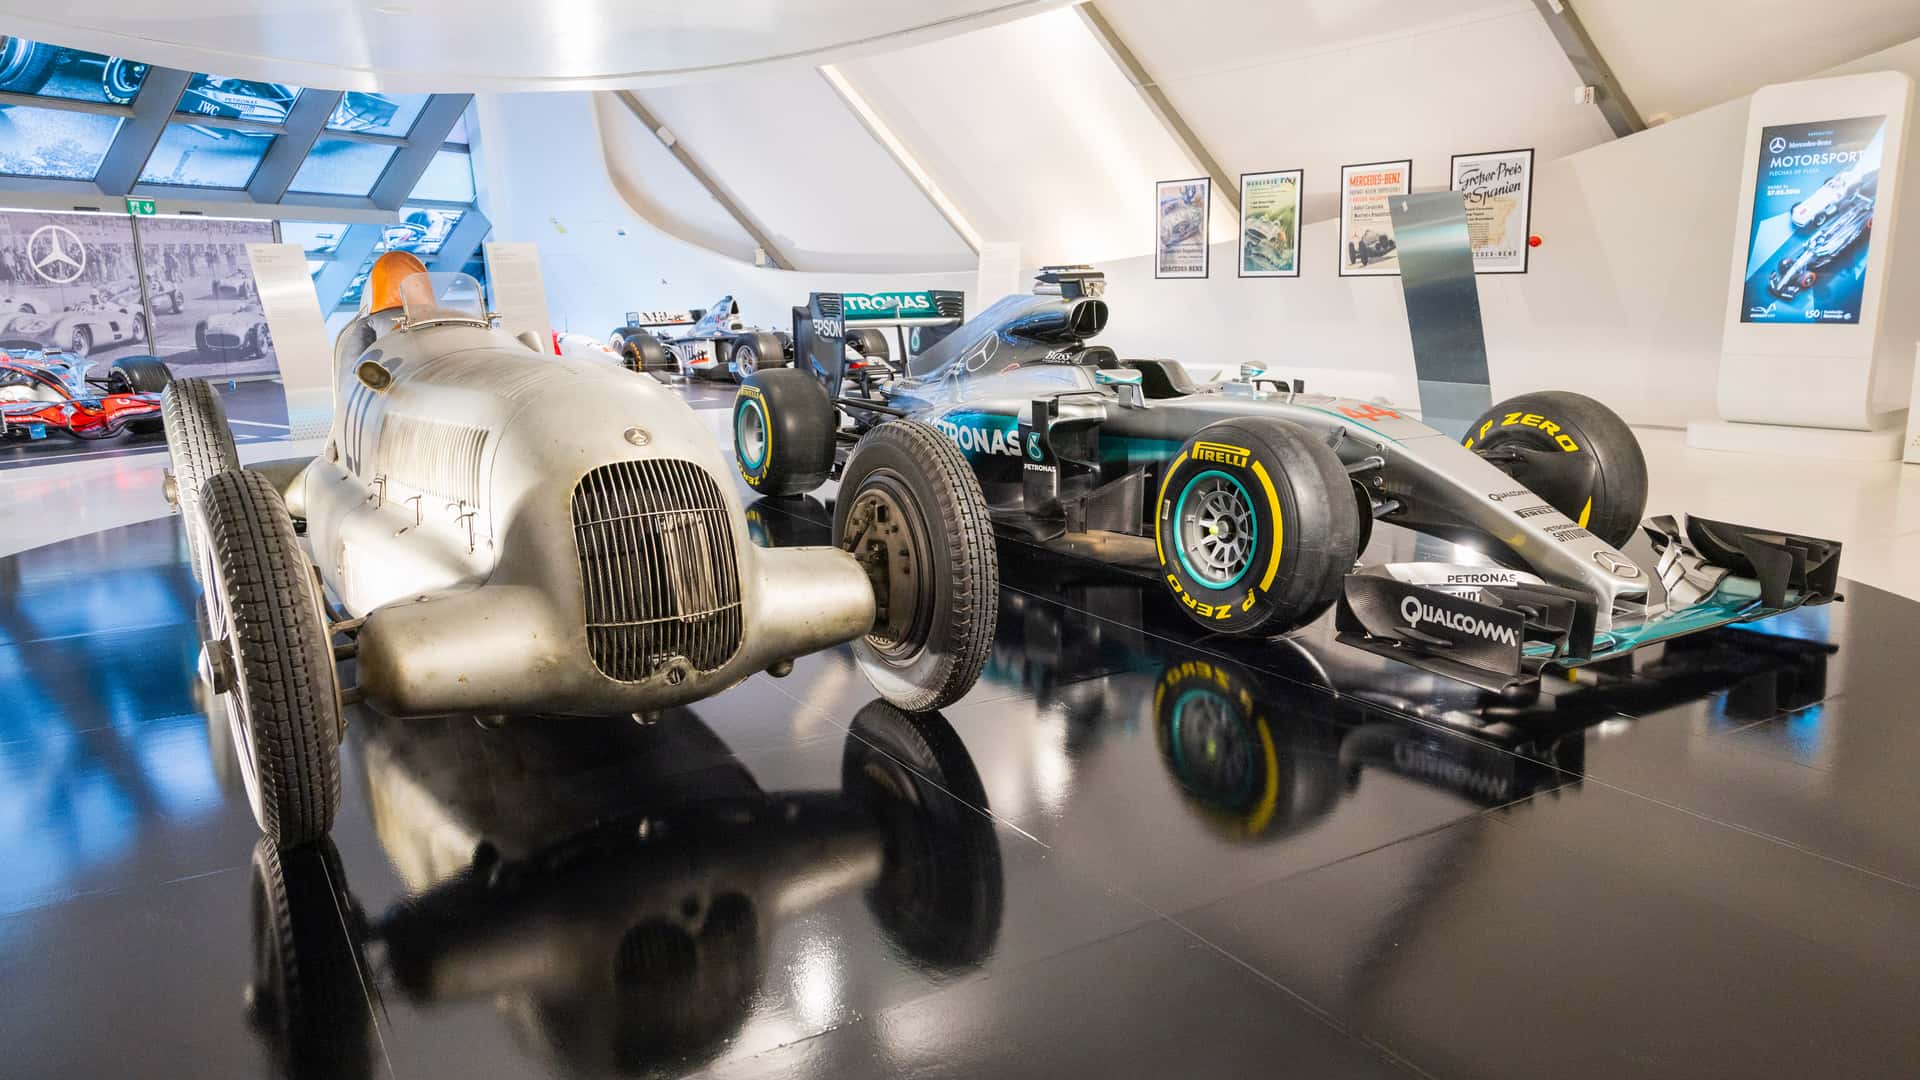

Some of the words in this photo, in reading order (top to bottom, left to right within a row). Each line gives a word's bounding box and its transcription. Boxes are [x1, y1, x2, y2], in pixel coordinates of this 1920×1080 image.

[197, 100, 220, 116] IWC
[1770, 151, 1864, 168] MOTORSPORT
[844, 295, 930, 310] TRONAS
[812, 318, 843, 338] EPSON
[1479, 419, 1494, 440] P
[1501, 411, 1580, 453] ZERO
[1191, 441, 1251, 469] PIRELLI
[1023, 463, 1057, 473] PETRONAS
[1447, 573, 1518, 584] PETRONAS
[1167, 573, 1232, 620] ZERO
[1241, 587, 1256, 612] P
[1400, 595, 1517, 647] QUALCOMM
